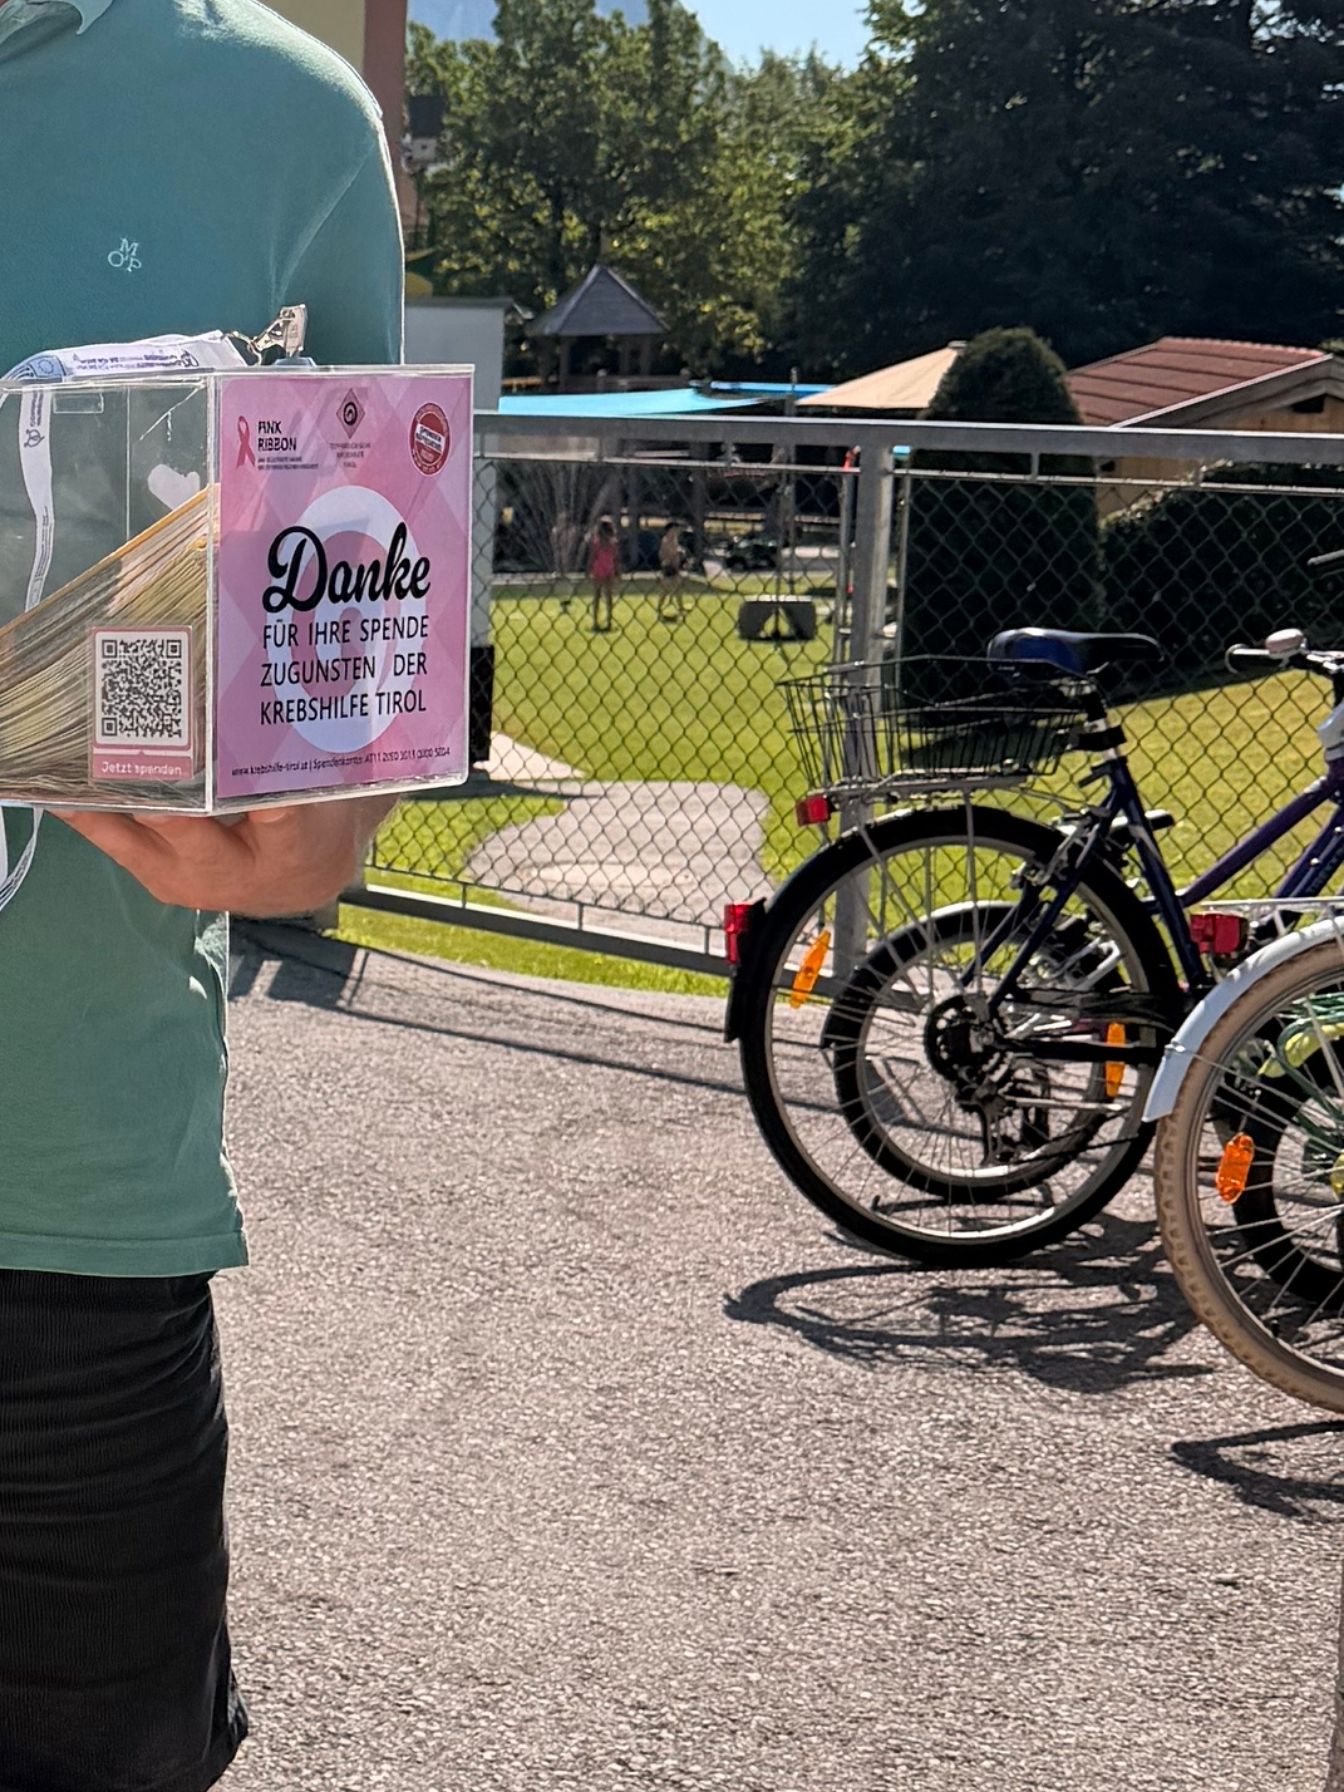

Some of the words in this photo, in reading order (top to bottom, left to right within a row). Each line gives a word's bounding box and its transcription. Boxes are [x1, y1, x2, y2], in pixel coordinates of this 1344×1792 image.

[262, 522, 431, 613] Danke
[263, 619, 299, 648] FÜR
[308, 620, 352, 646] IHRE
[360, 615, 430, 642] SPENDE
[261, 656, 376, 687] ZUGUNSTEN
[393, 652, 428, 677] DER
[261, 694, 369, 725] KREBSHILFE
[376, 689, 427, 716] TIROL
